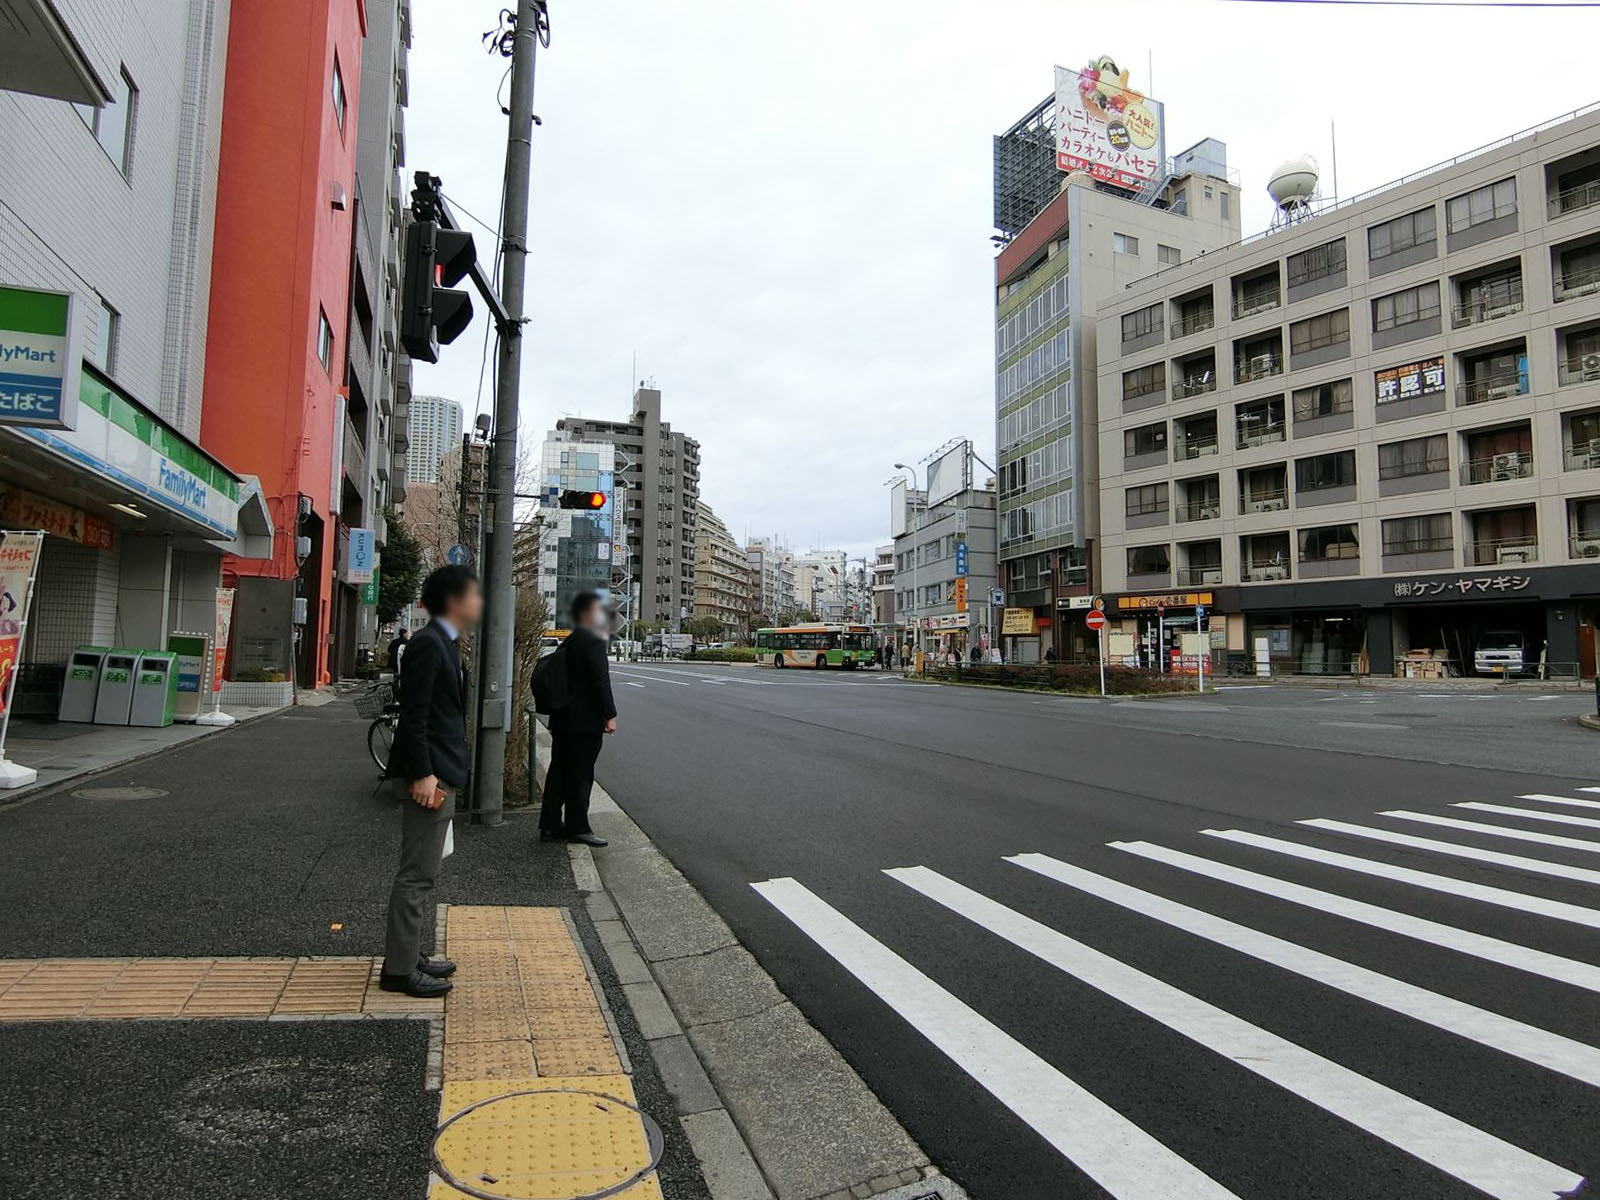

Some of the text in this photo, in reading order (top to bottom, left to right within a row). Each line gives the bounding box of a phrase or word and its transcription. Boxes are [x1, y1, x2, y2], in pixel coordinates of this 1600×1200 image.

[1059, 104, 1105, 126] ハニトー
[1060, 121, 1105, 142] パーティー
[1378, 369, 1444, 398] 許認可
[159, 458, 207, 510] FamilyMart
[356, 532, 366, 567] KUMON
